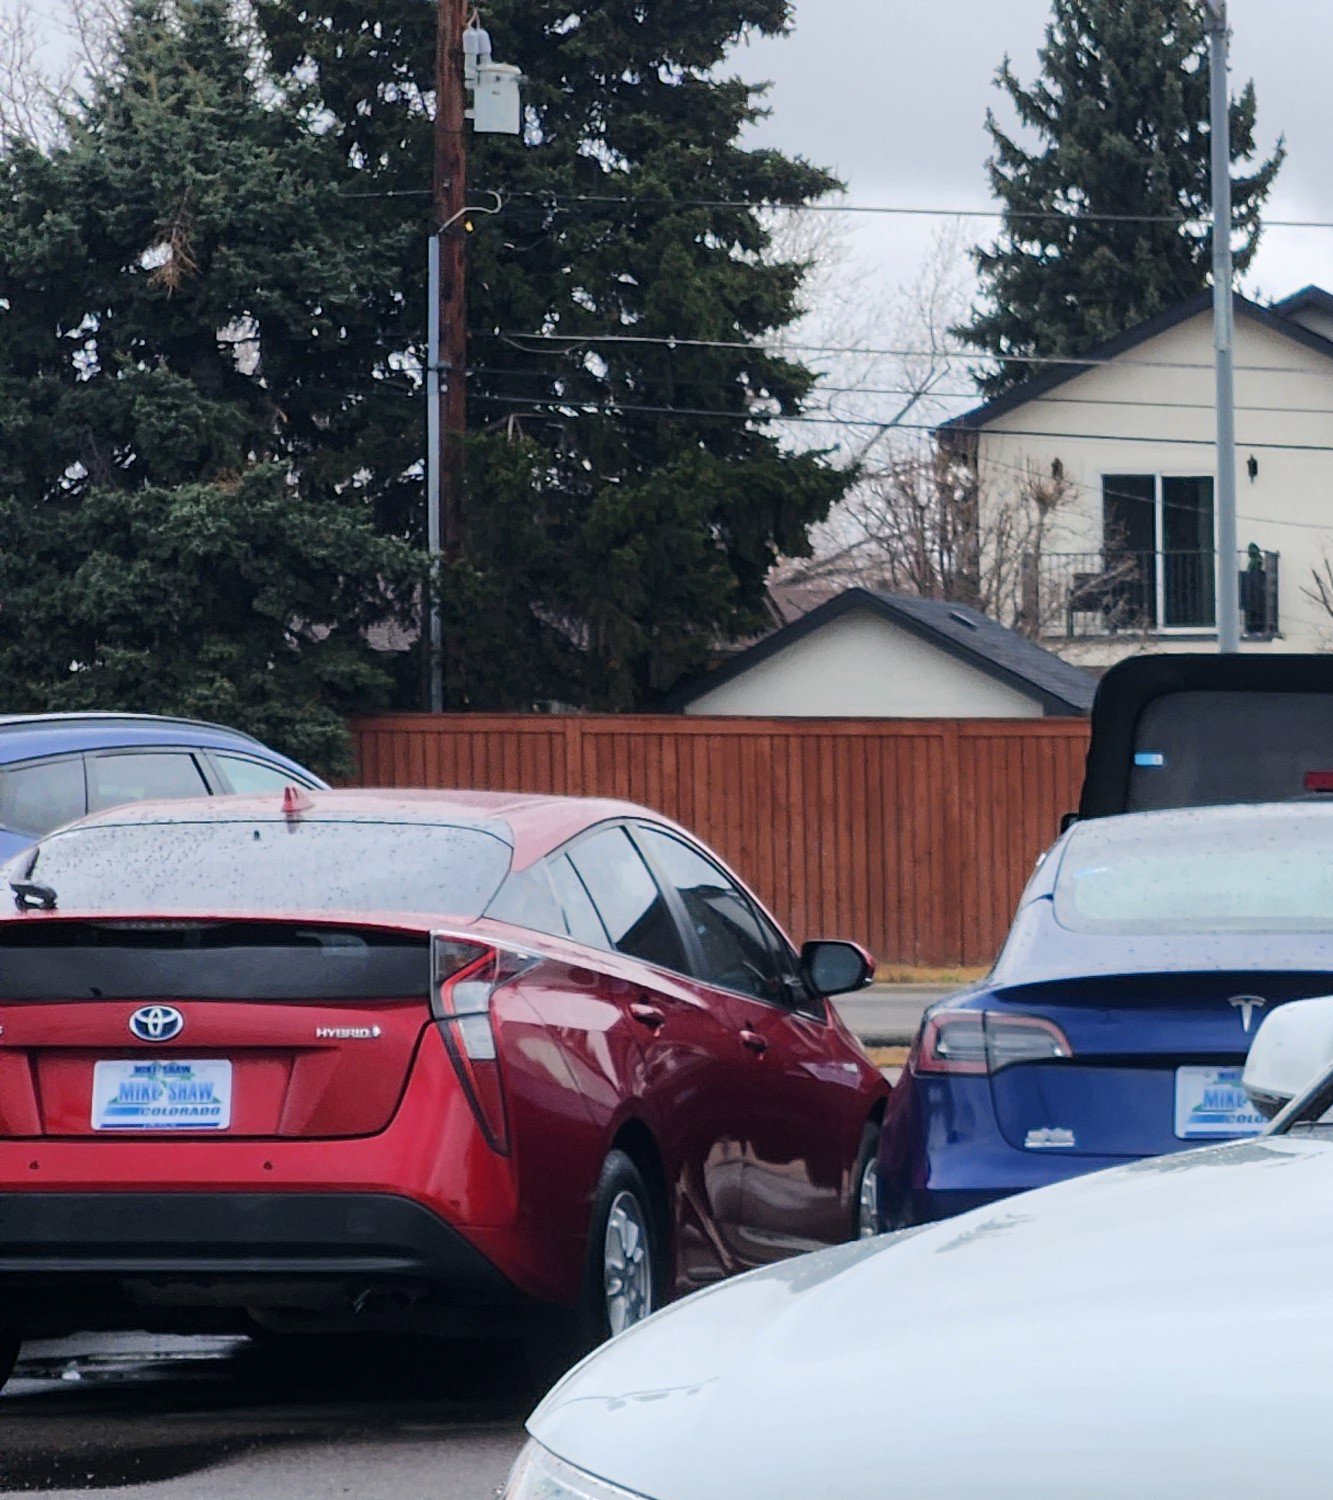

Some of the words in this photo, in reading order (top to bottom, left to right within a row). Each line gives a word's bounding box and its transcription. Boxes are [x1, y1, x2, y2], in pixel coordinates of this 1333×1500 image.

[316, 1026, 371, 1038] HYBRID
[119, 1081, 159, 1102] MIKE
[168, 1081, 214, 1103] SHAW
[140, 1107, 221, 1116] COLORADO
